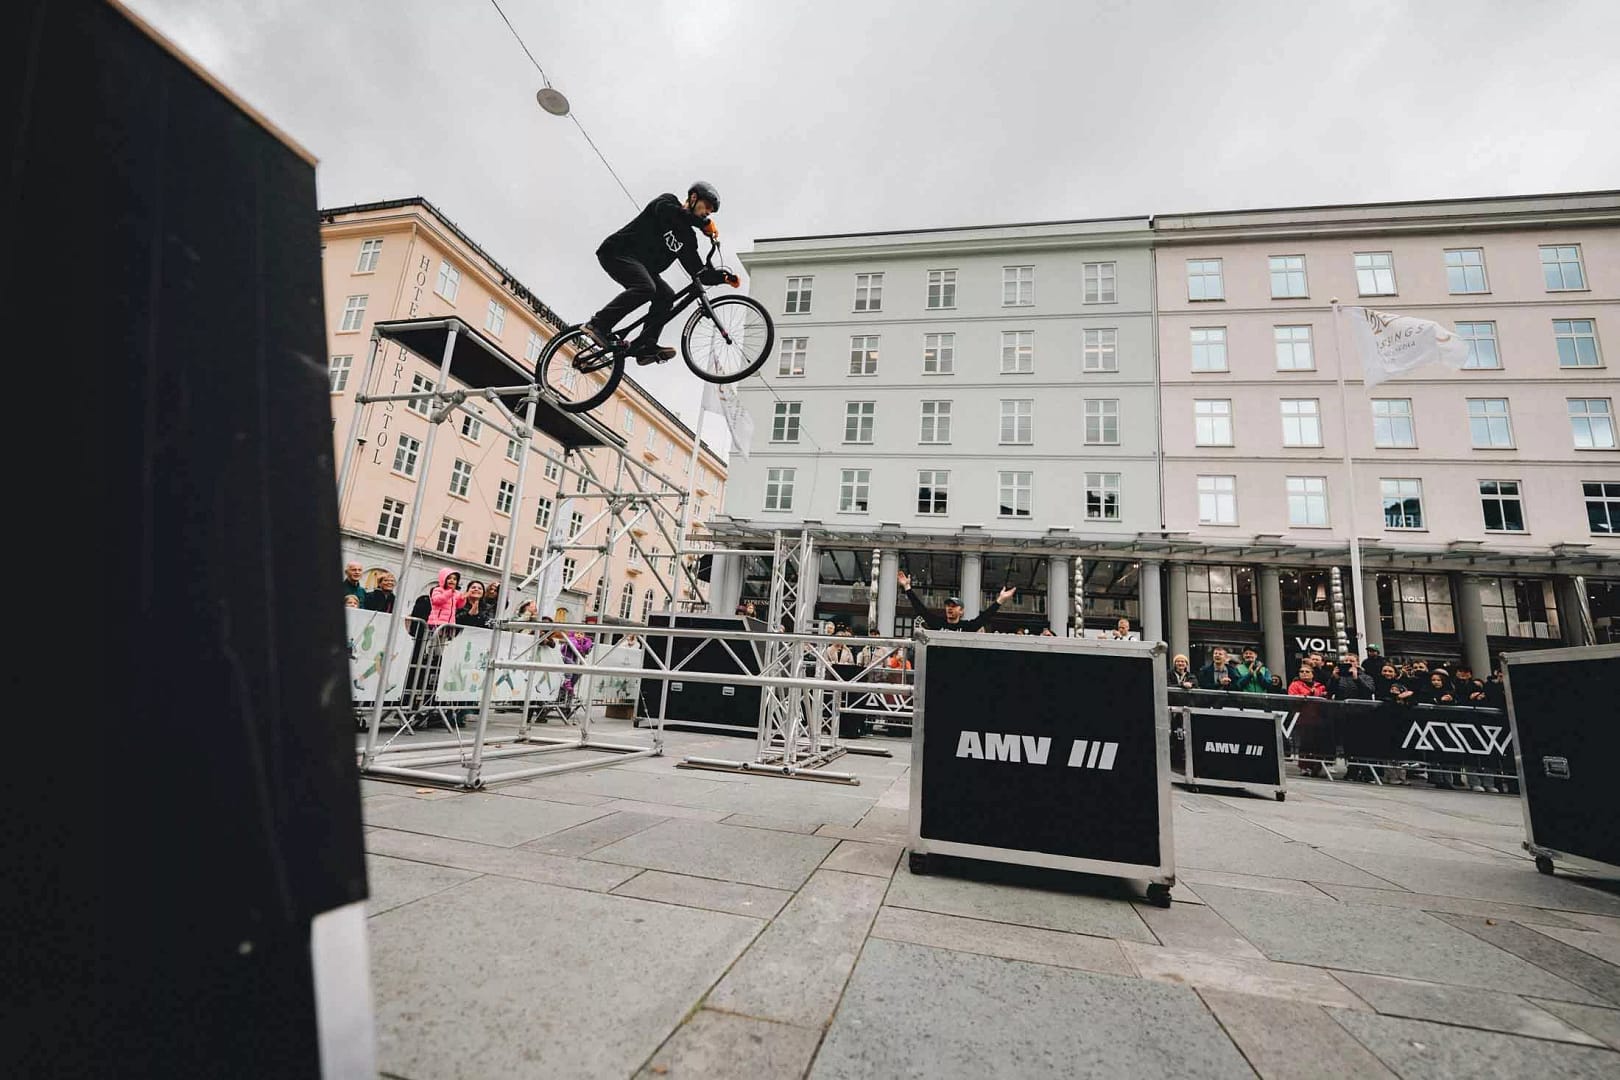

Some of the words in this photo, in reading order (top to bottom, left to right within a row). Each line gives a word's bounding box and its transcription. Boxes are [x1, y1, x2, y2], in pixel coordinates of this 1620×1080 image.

[409, 255, 430, 318] HOTE
[1296, 637, 1350, 651] VOL
[956, 731, 1052, 765] AMV
[1205, 741, 1240, 754] AMV
